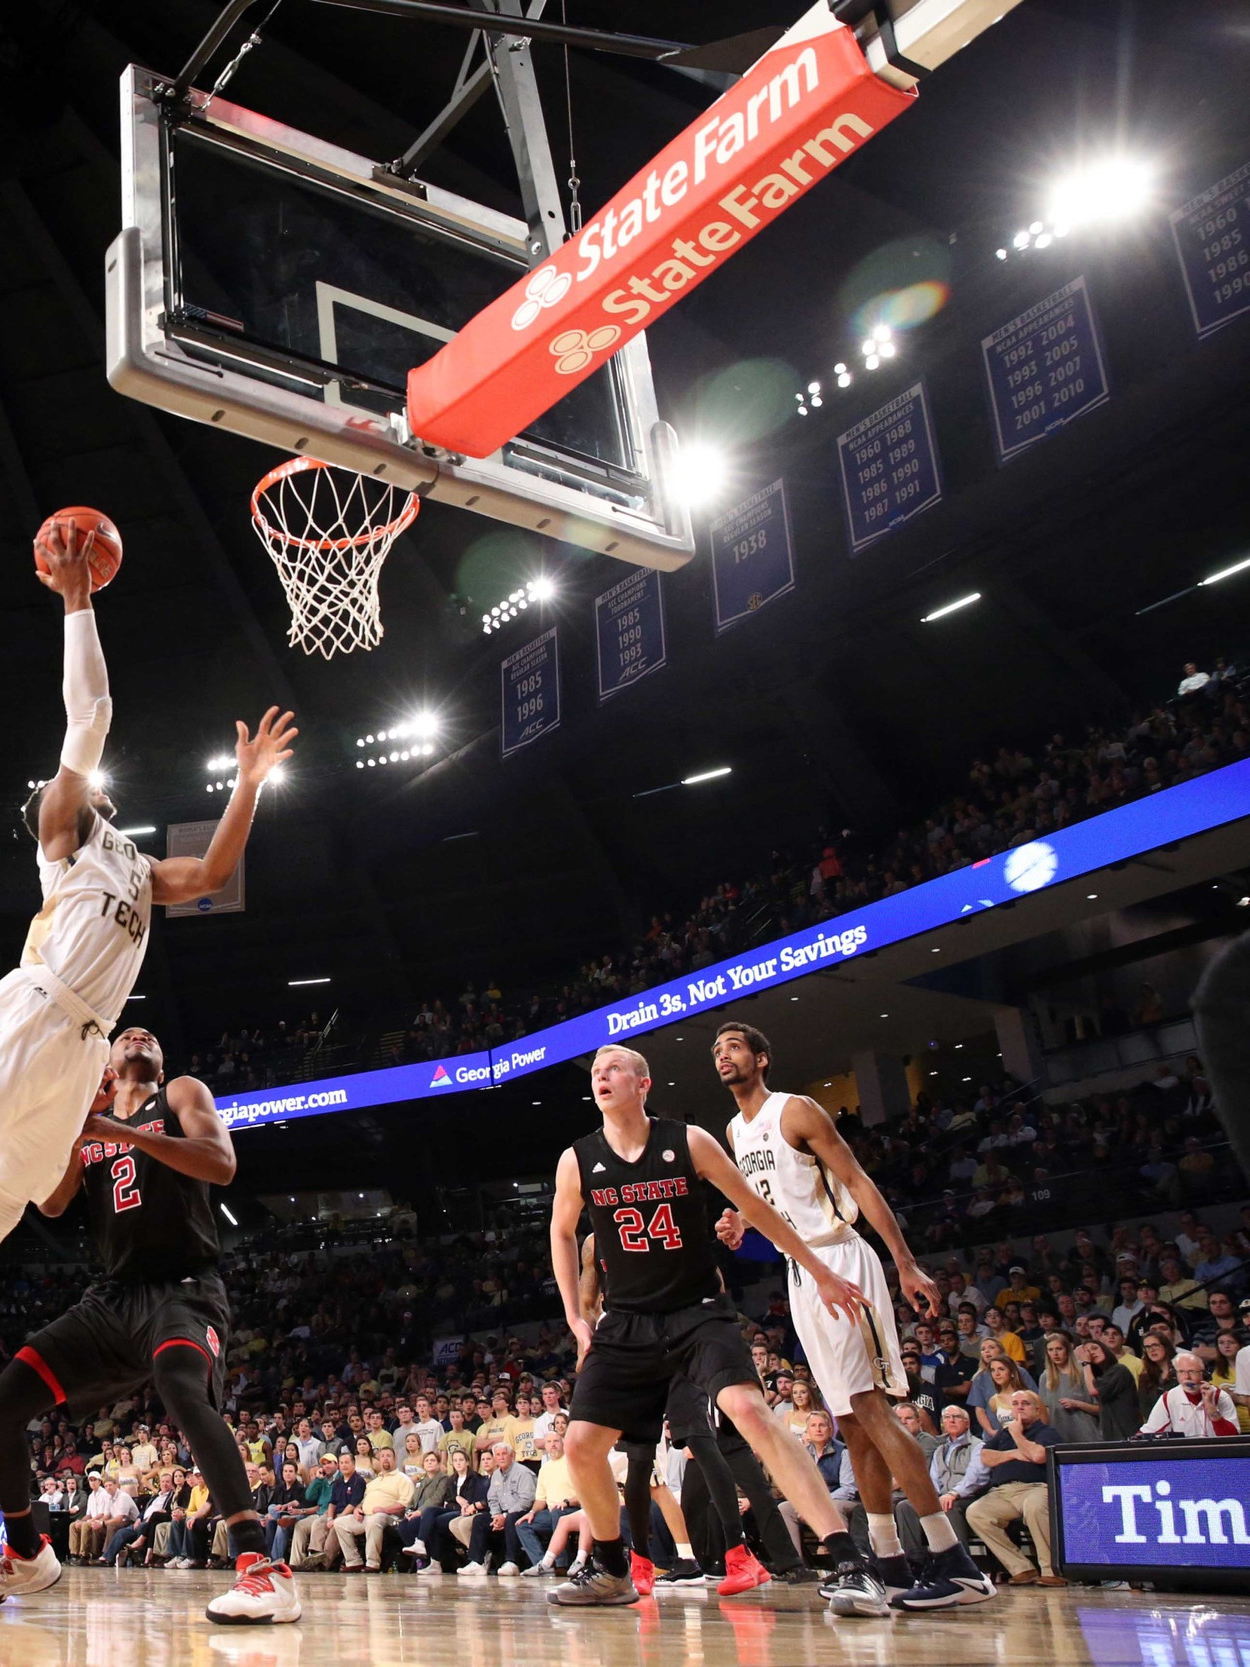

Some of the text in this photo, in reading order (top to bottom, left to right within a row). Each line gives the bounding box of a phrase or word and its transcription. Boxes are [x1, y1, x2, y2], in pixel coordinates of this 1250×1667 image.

[1198, 208, 1237, 241] 1960
[1202, 228, 1242, 262] 1985
[1208, 249, 1249, 283] 1986
[1019, 299, 1075, 338] APPEARANCES
[1004, 315, 1075, 368] 1992 2004
[1007, 335, 1078, 389] 1993 2005
[1011, 355, 1082, 409] 1996 2007
[867, 402, 914, 441] APPEARANCES
[1015, 378, 1085, 430] 2001 2010
[855, 420, 912, 465] 1960 1988
[858, 439, 915, 484] 1985 1989
[861, 458, 919, 504] 1986 1990
[864, 480, 920, 523] 1987 1991
[733, 529, 767, 564] 1938
[617, 579, 647, 604] CHAMPIONS
[617, 608, 640, 632] 1985
[618, 625, 642, 650] 1990
[618, 656, 648, 681] ACC
[619, 642, 642, 667] 1993
[516, 670, 542, 700] 1985
[517, 693, 544, 723] 1996
[519, 717, 544, 740] ACC
[101, 892, 146, 949] TECH
[606, 924, 868, 1036] Drain 3s, Not Your Savings
[456, 1046, 546, 1084] Georgia Power
[111, 1155, 142, 1214] 2
[590, 1176, 689, 1207] NC STATE
[1031, 1189, 1051, 1201] 109
[613, 1203, 683, 1252] 24
[873, 1357, 890, 1374] GT
[515, 1431, 534, 1445] GEORG
[1102, 1480, 1250, 1544] Tim
